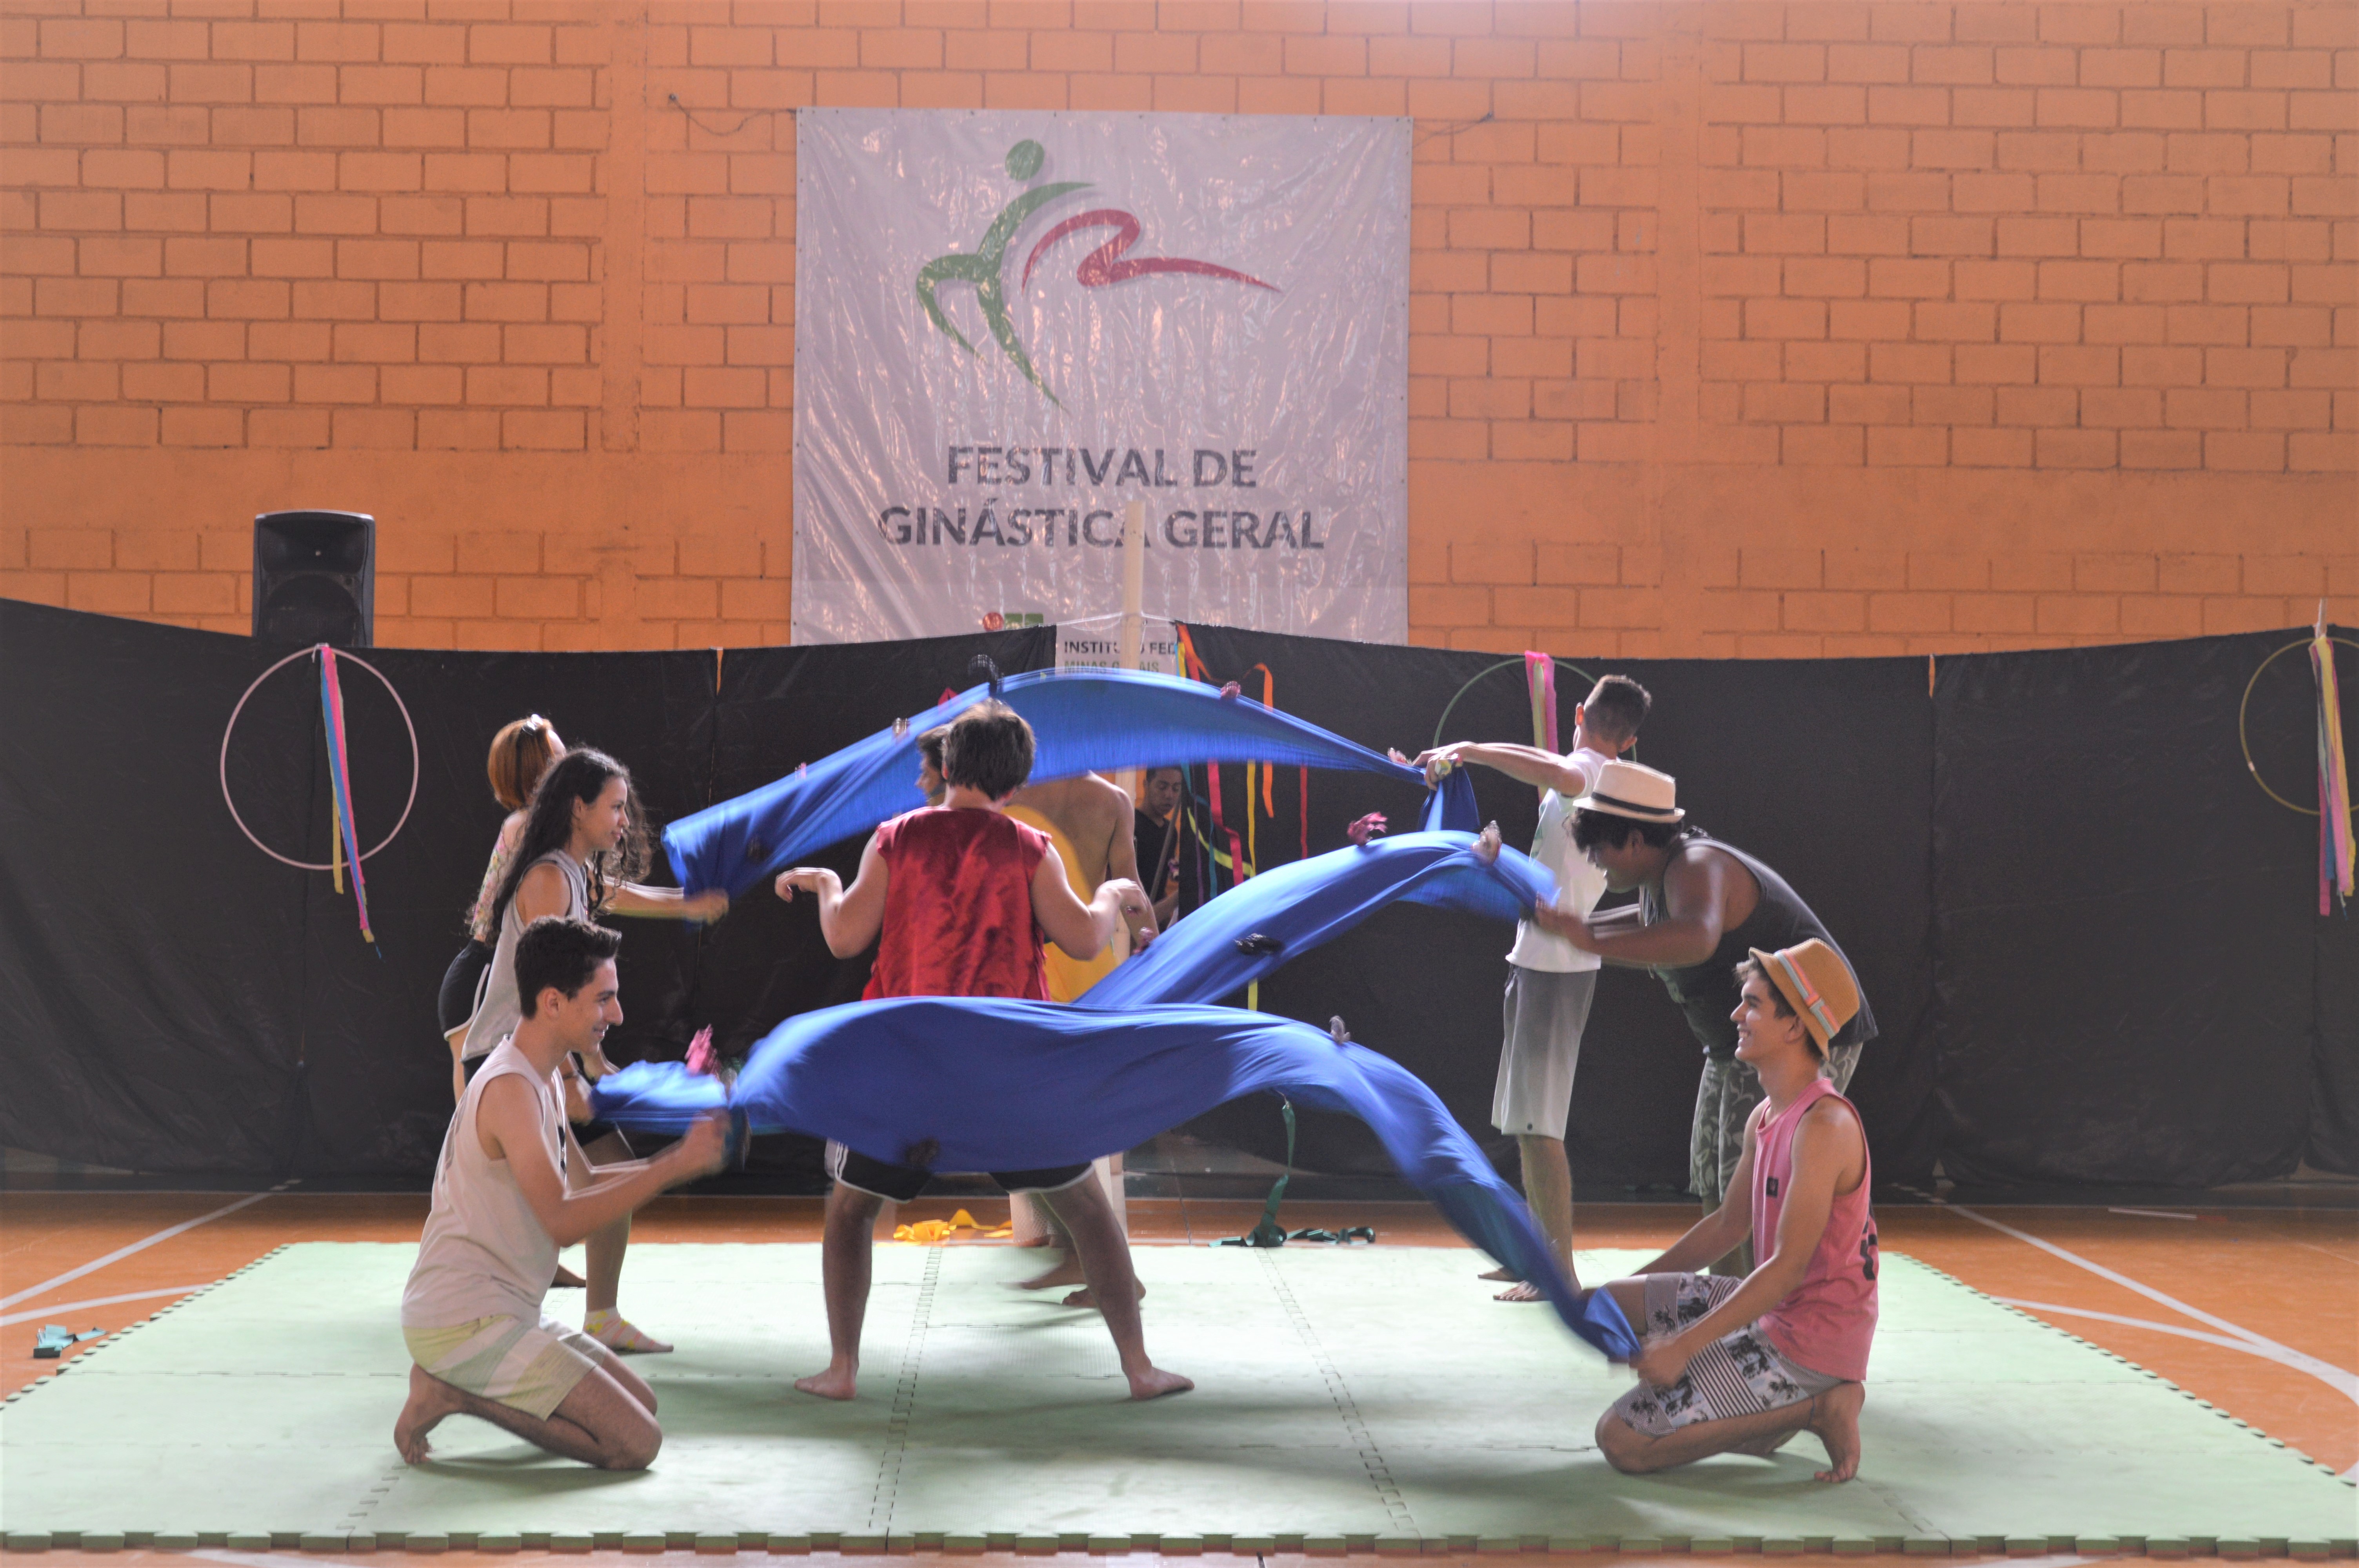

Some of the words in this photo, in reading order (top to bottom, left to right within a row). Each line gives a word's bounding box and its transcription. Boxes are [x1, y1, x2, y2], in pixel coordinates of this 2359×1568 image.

[947, 446, 1178, 486] FESTIVAL
[1193, 449, 1256, 487] DE
[1165, 510, 1324, 549] GERAL
